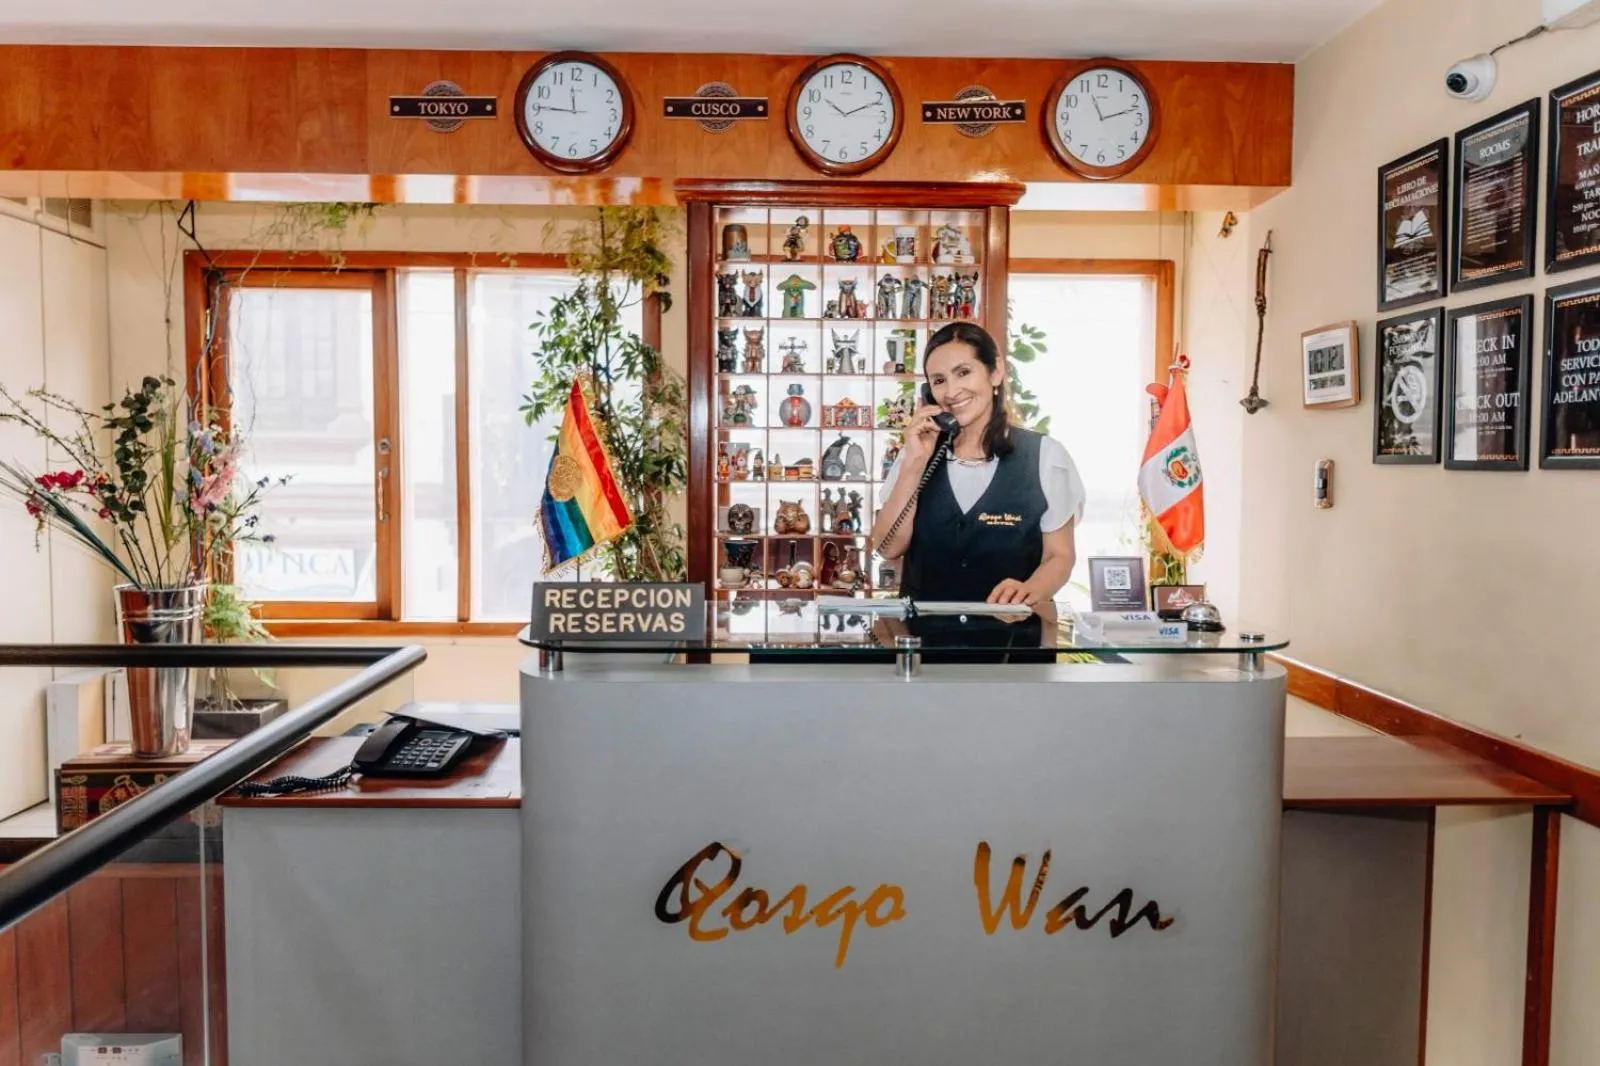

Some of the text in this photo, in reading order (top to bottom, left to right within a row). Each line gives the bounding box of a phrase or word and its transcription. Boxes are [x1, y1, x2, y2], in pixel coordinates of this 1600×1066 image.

[552, 72, 564, 85] 11
[570, 67, 584, 82] 12
[592, 74, 598, 88] 1
[841, 70, 853, 85] 12
[1097, 74, 1109, 88] 12
[824, 75, 834, 89] 11
[862, 76, 868, 89] 1
[1080, 80, 1091, 93] 11
[1118, 80, 1124, 92] 1
[537, 86, 551, 99] 10
[606, 89, 615, 103] 2
[808, 89, 822, 103] 10
[876, 92, 884, 105] 2
[1065, 95, 1079, 109] 10
[1131, 94, 1140, 108] 2
[418, 101, 469, 116] TOKYO
[532, 103, 541, 116] 9
[609, 108, 618, 122] 3
[691, 102, 740, 116] CUSCO
[803, 107, 812, 119] 9
[936, 106, 1012, 120] NEW YORK
[879, 110, 888, 124] 3
[1060, 112, 1070, 125] 9
[1135, 112, 1144, 126] 3
[535, 122, 544, 134] 8
[604, 127, 613, 140] 4
[806, 125, 815, 137] 8
[874, 128, 882, 141] 4
[1063, 130, 1072, 143] 8
[1130, 131, 1139, 144] 4
[551, 137, 560, 150] 7
[568, 143, 577, 156] 6
[590, 140, 599, 152] 5
[822, 140, 831, 154] 7
[860, 142, 869, 155] 5
[839, 146, 848, 159] 6
[1080, 145, 1089, 158] 7
[1097, 152, 1106, 164] 6
[1117, 145, 1125, 158] 5
[1396, 175, 1427, 195] LIBRO DE
[1502, 334, 1516, 350] IN
[1491, 353, 1506, 366] AM
[1562, 372, 1586, 387] CON
[1495, 392, 1520, 408] OUT
[1491, 411, 1506, 422] AM
[544, 588, 691, 609] RECEPCION
[550, 612, 686, 633] RESERVAS
[1158, 627, 1181, 636] VISA
[654, 841, 906, 969] Qosqo
